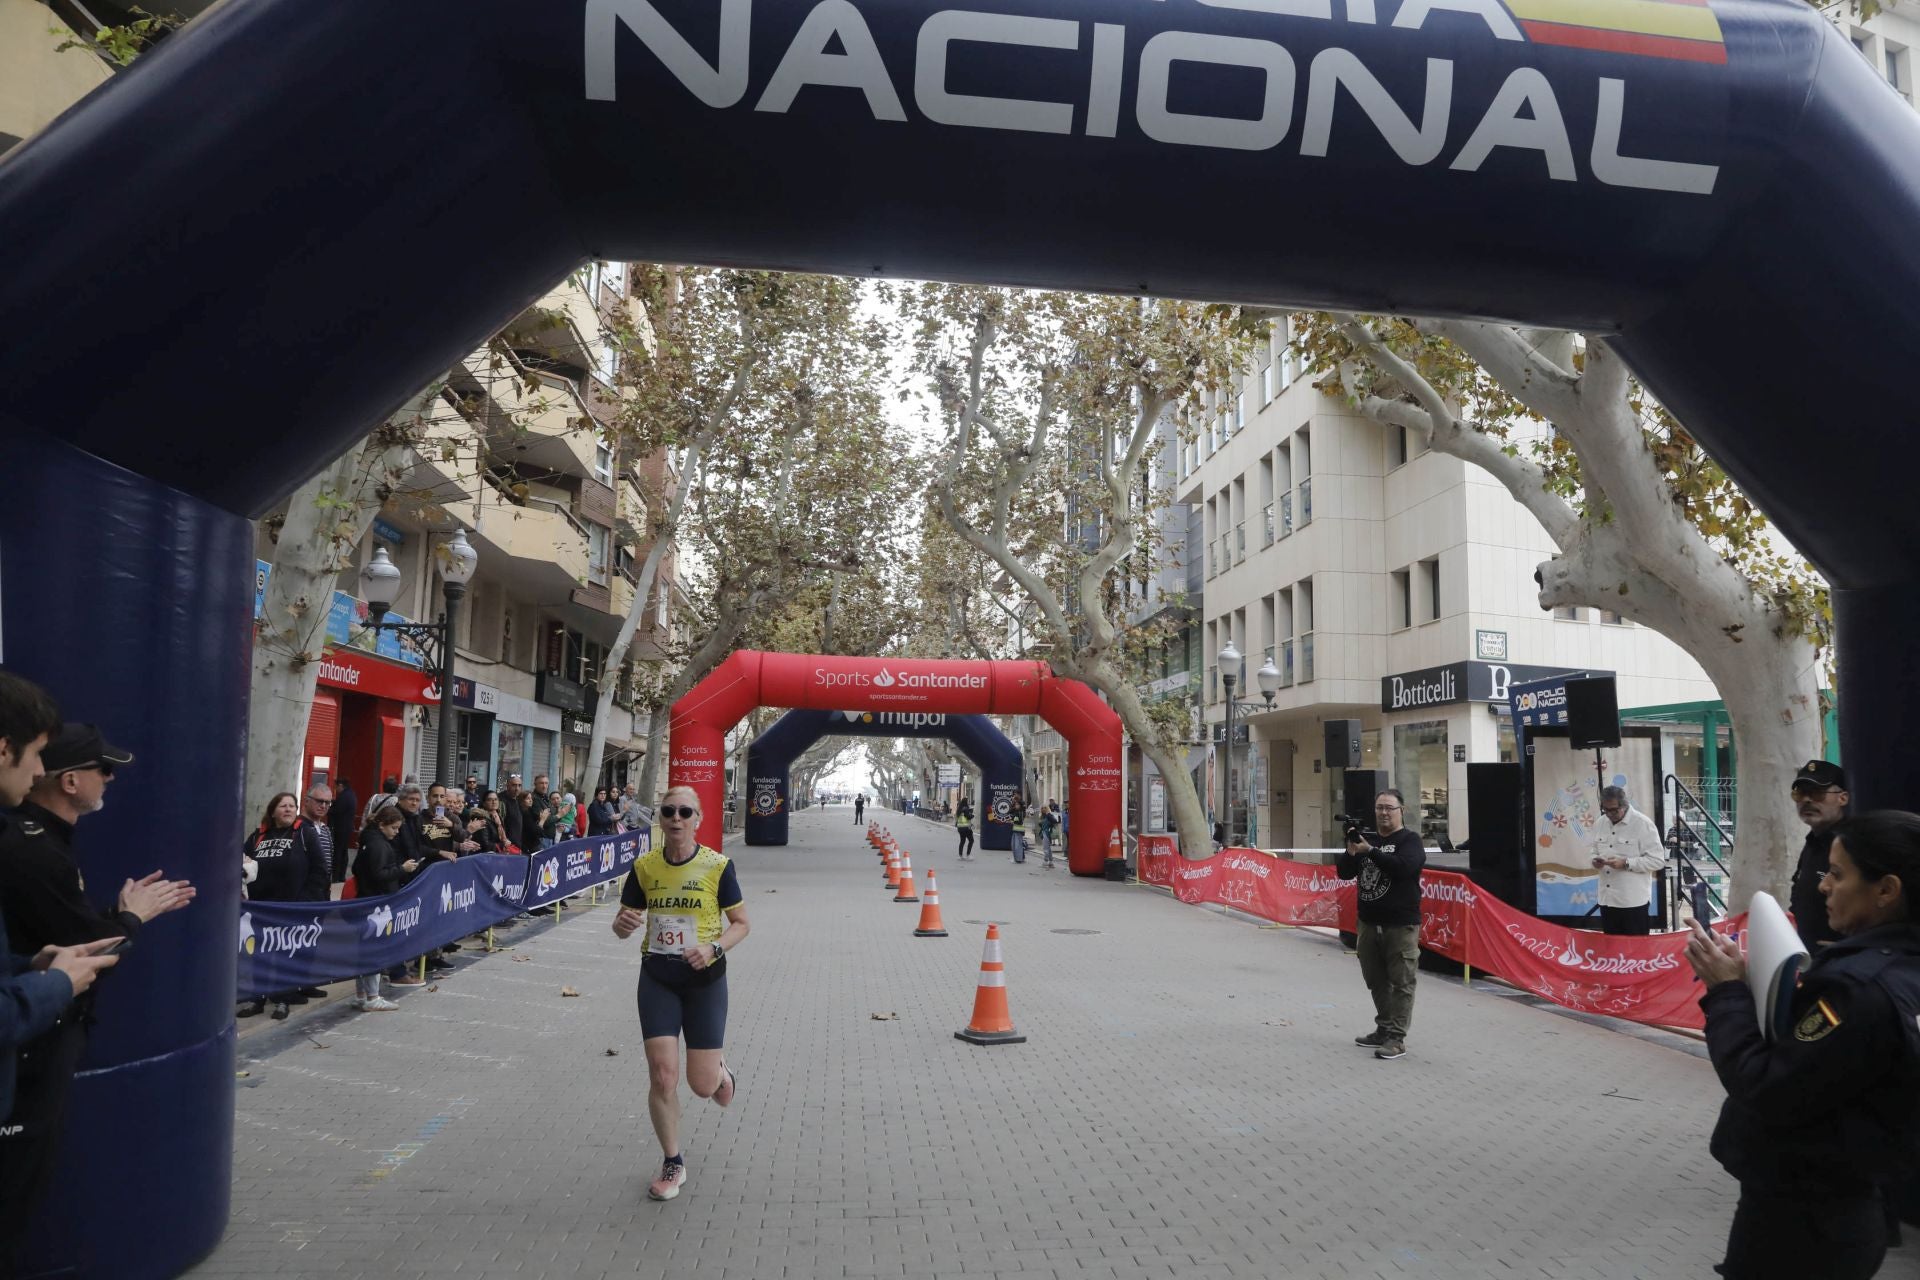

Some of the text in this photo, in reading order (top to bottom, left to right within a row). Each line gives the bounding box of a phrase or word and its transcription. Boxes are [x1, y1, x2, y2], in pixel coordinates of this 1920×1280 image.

[584, 0, 1719, 195] NACIONAL
[319, 660, 360, 685] antander
[815, 668, 987, 689] Sports Santander
[1391, 669, 1456, 709] Botticelli
[1537, 687, 1565, 699] POLICI
[1515, 693, 1537, 711] 200
[1538, 696, 1567, 708] NACION
[1088, 755, 1113, 763] Sports
[600, 842, 615, 873] 200
[566, 863, 592, 881] NACIONAL
[453, 880, 475, 912] mupol
[394, 897, 422, 936] mupol
[260, 916, 323, 958] mupol
[656, 931, 684, 945] 431
[1580, 949, 1680, 974] Santander
